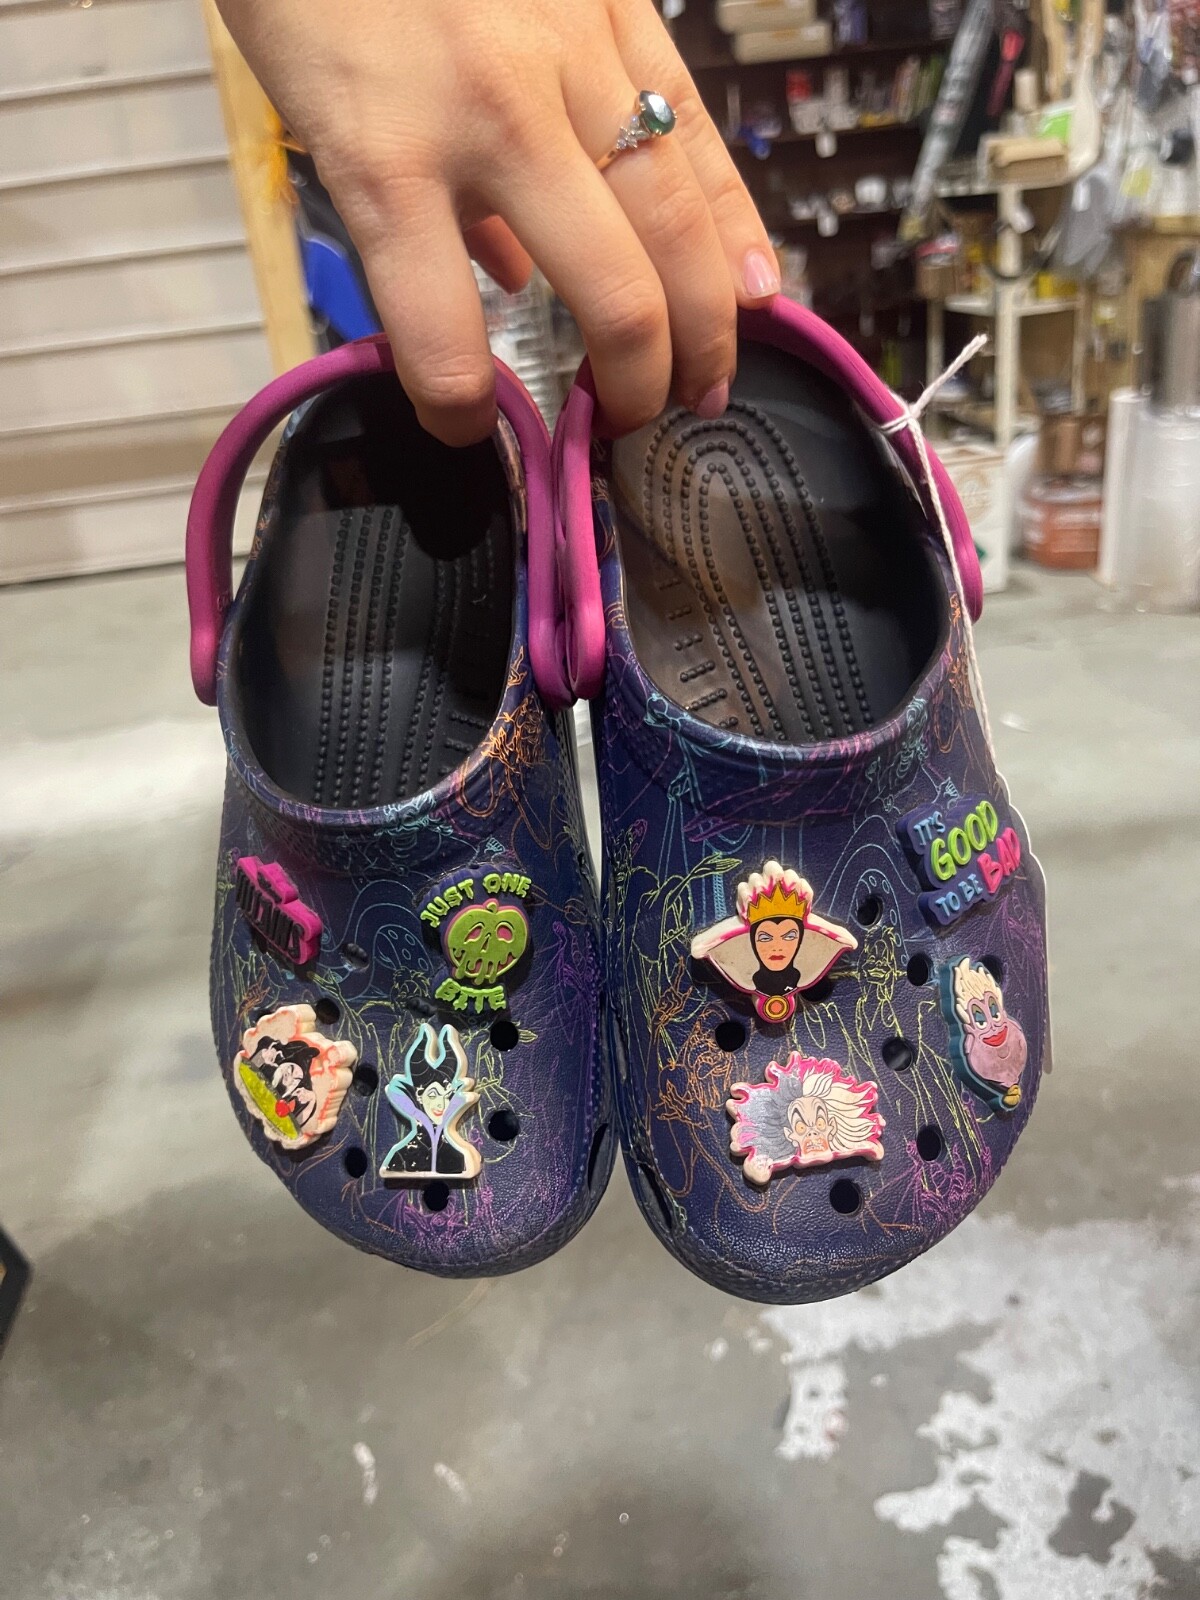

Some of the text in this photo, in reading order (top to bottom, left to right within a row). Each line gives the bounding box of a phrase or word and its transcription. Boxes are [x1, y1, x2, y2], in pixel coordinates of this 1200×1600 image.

[914, 810, 946, 846] IT'S
[930, 800, 998, 881] GOOD
[420, 872, 532, 928] JUST ONE
[935, 827, 1021, 917] TO BE BAD
[435, 978, 506, 1014] BITE
